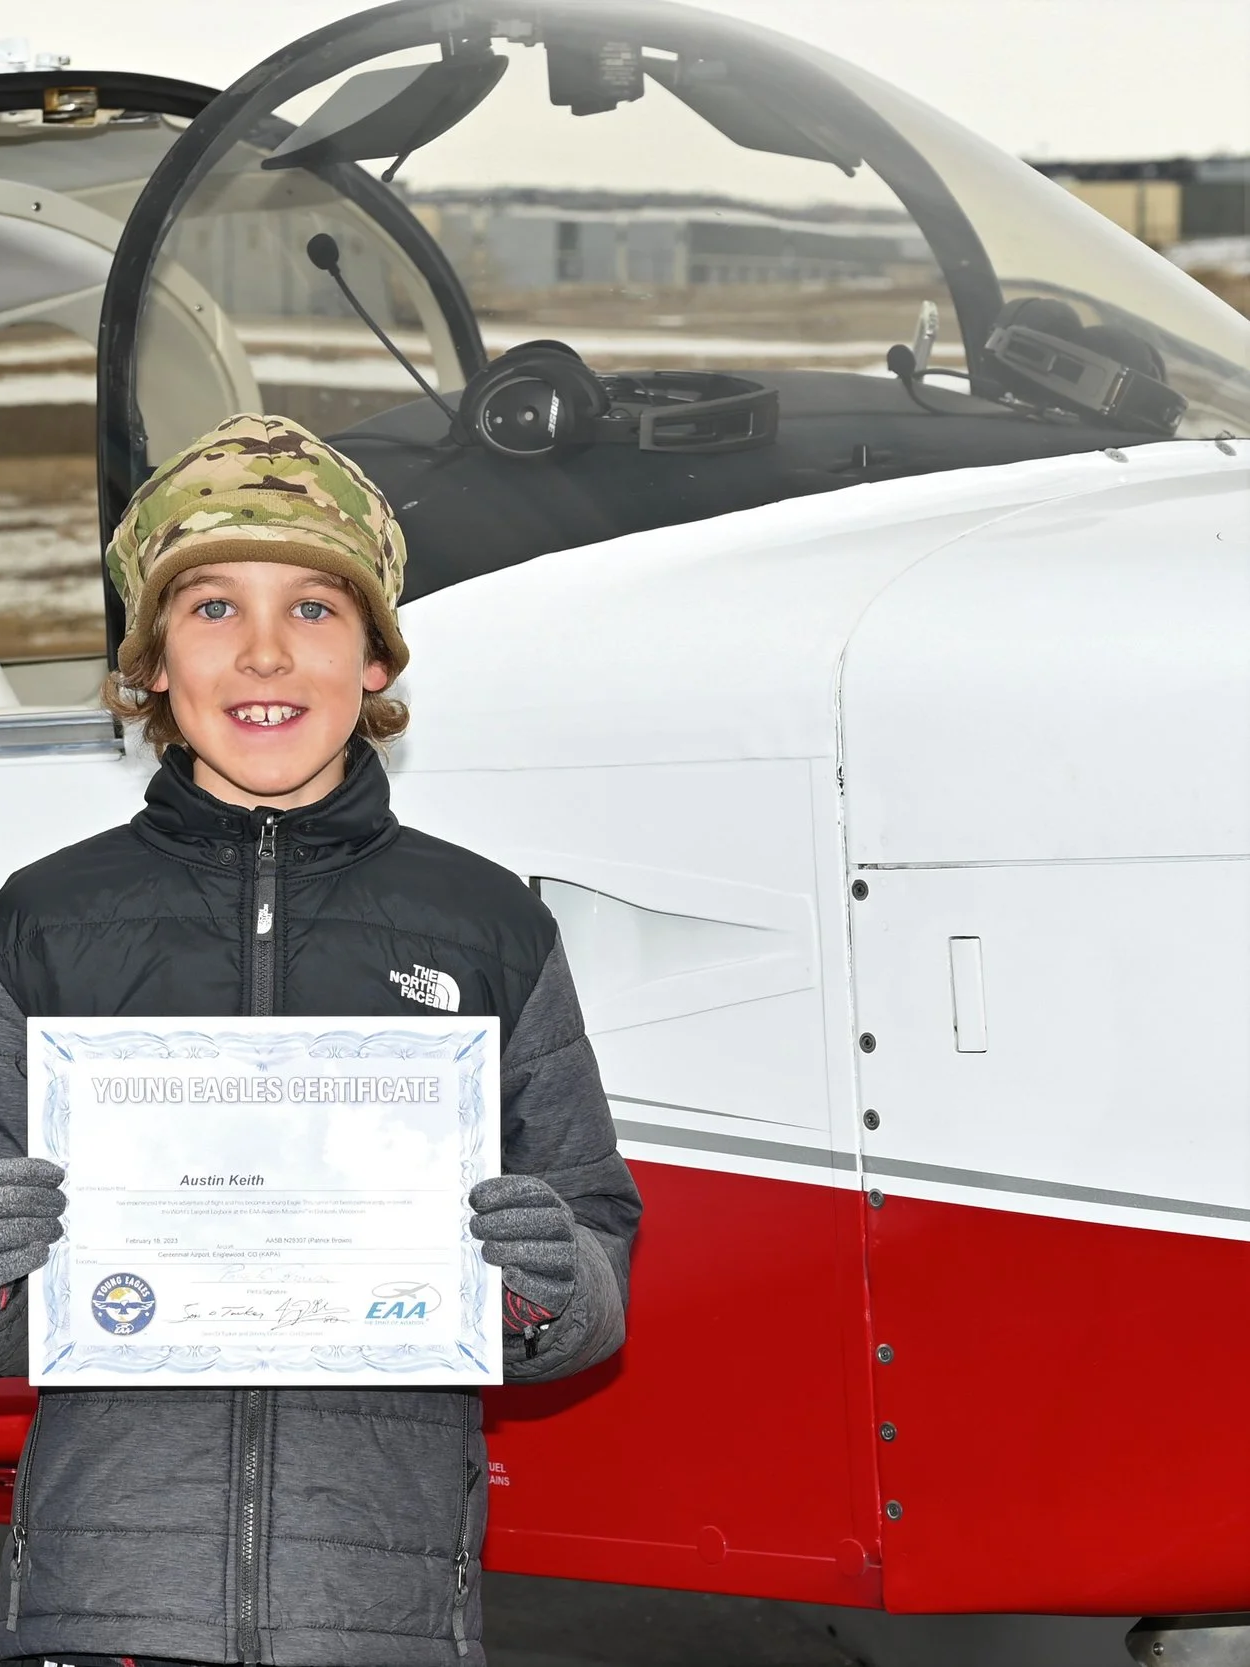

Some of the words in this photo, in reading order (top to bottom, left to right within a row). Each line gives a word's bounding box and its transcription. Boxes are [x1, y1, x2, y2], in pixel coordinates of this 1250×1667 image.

[390, 970, 436, 994] NORTH
[413, 964, 438, 983] THE
[401, 985, 434, 1007] FACE
[91, 1077, 183, 1104] YOUNG
[188, 1077, 283, 1104] EAGLES
[287, 1077, 440, 1104] CERTIFICATE
[180, 1174, 224, 1186] Austin
[229, 1174, 264, 1186] Keith
[97, 1276, 122, 1297] YOUNG
[125, 1276, 150, 1297] EAGLES
[365, 1302, 426, 1319] EAA
[488, 1462, 506, 1473] UEL
[488, 1475, 510, 1487] AINS
